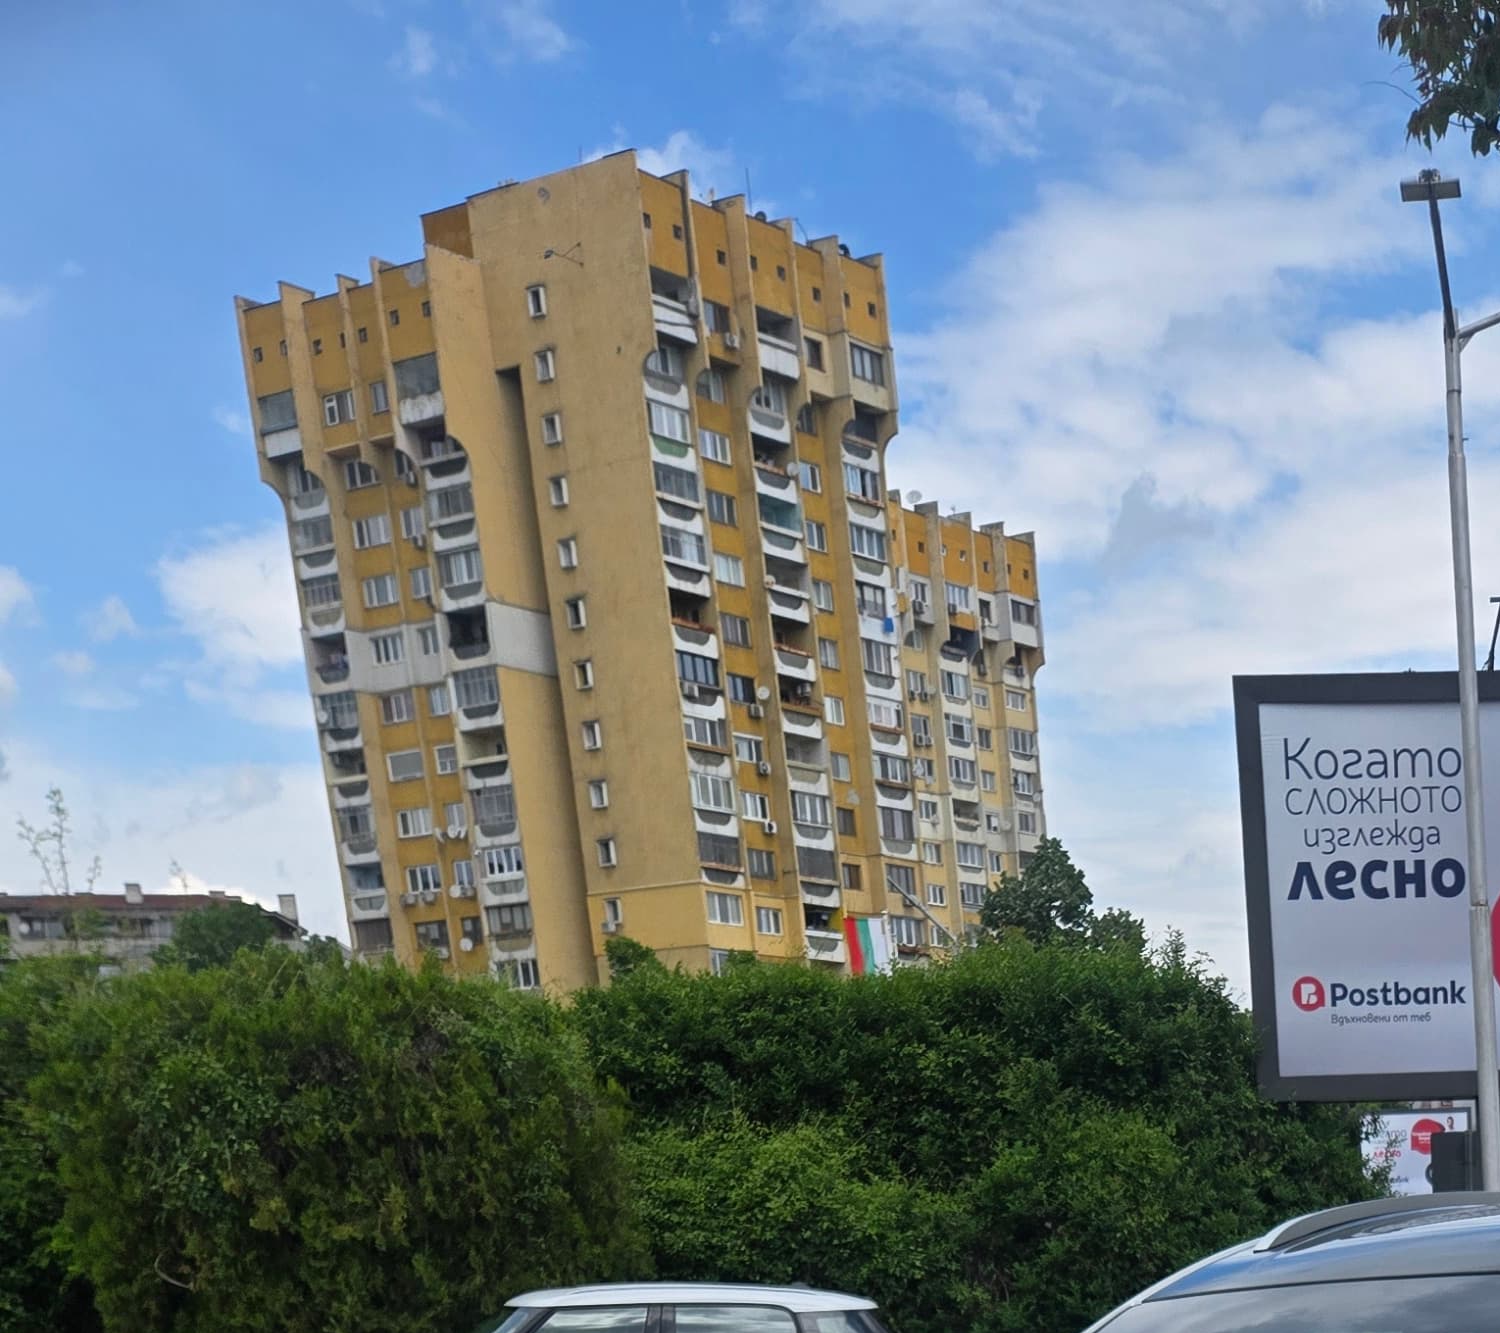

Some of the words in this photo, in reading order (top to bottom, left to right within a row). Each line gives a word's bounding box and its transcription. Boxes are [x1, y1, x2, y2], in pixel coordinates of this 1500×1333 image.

[1284, 737, 1462, 780] Когато
[1303, 819, 1441, 856] изглежда
[1330, 980, 1467, 1008] Postbank
[1331, 1013, 1392, 1027] Вдъхновени
[1393, 1014, 1408, 1022] от
[1410, 1011, 1432, 1023] теб
